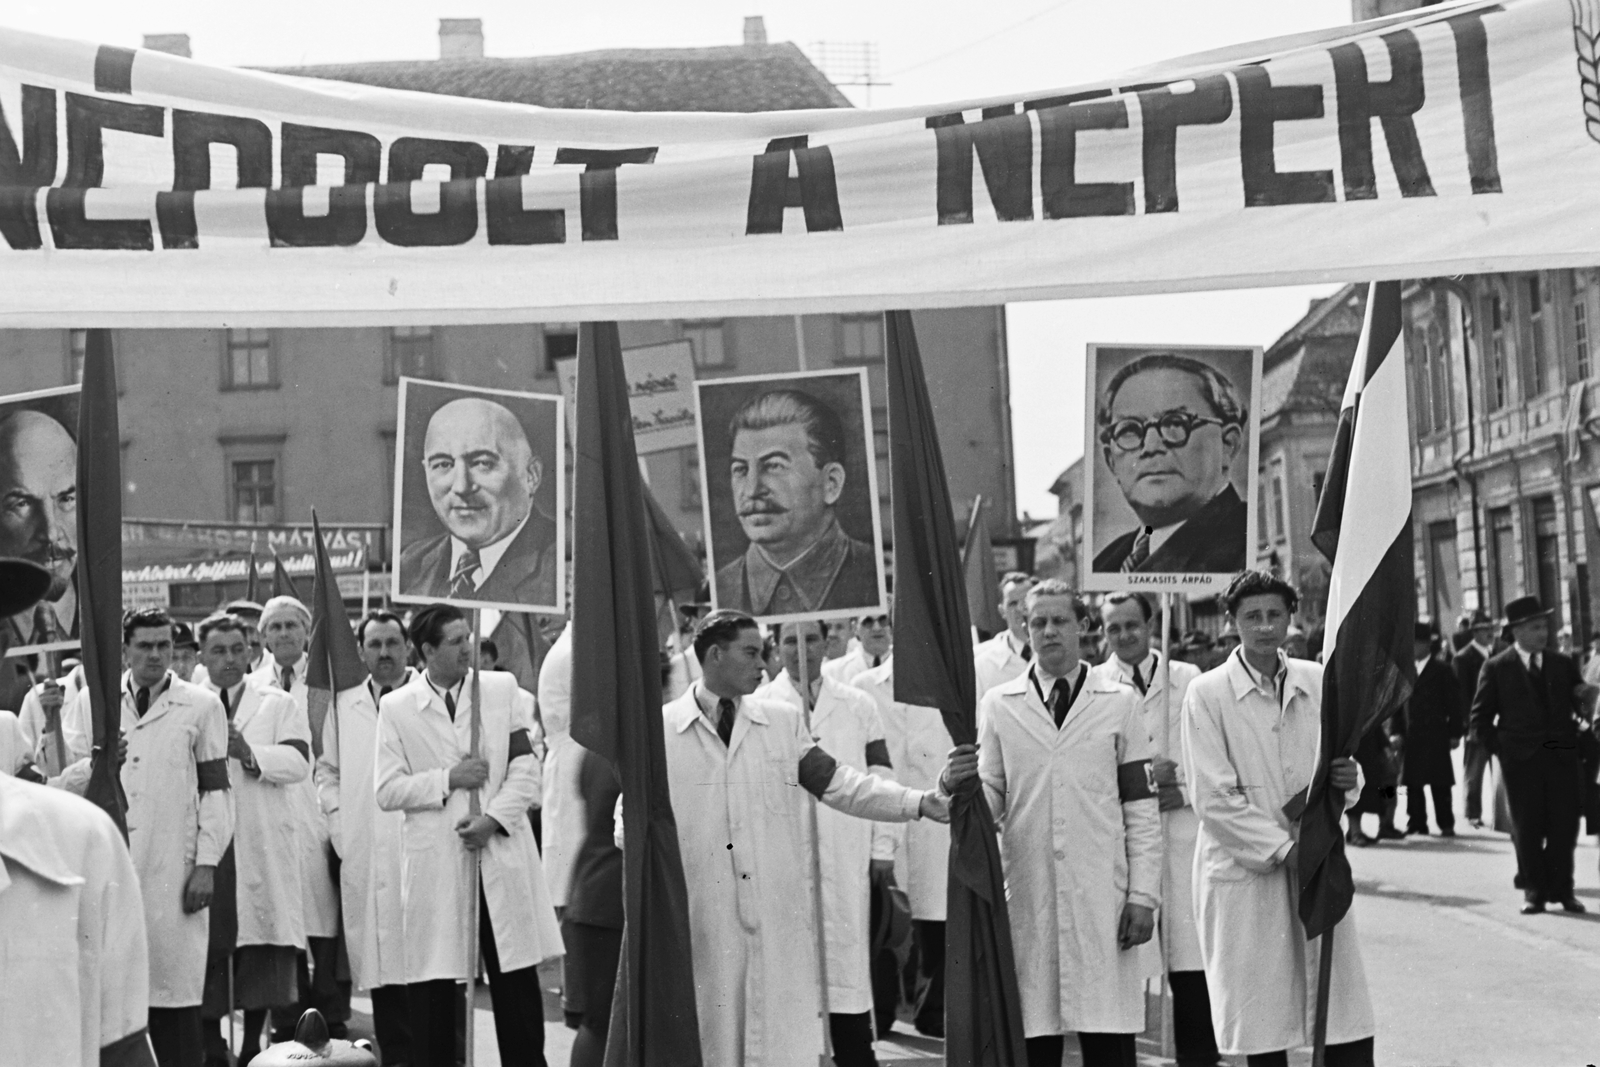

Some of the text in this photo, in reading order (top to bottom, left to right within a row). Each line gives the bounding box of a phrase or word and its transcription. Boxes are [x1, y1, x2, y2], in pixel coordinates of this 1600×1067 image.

[746, 135, 843, 234] A
[1127, 574, 1213, 585] SZAKASITS ÁRPÁD
